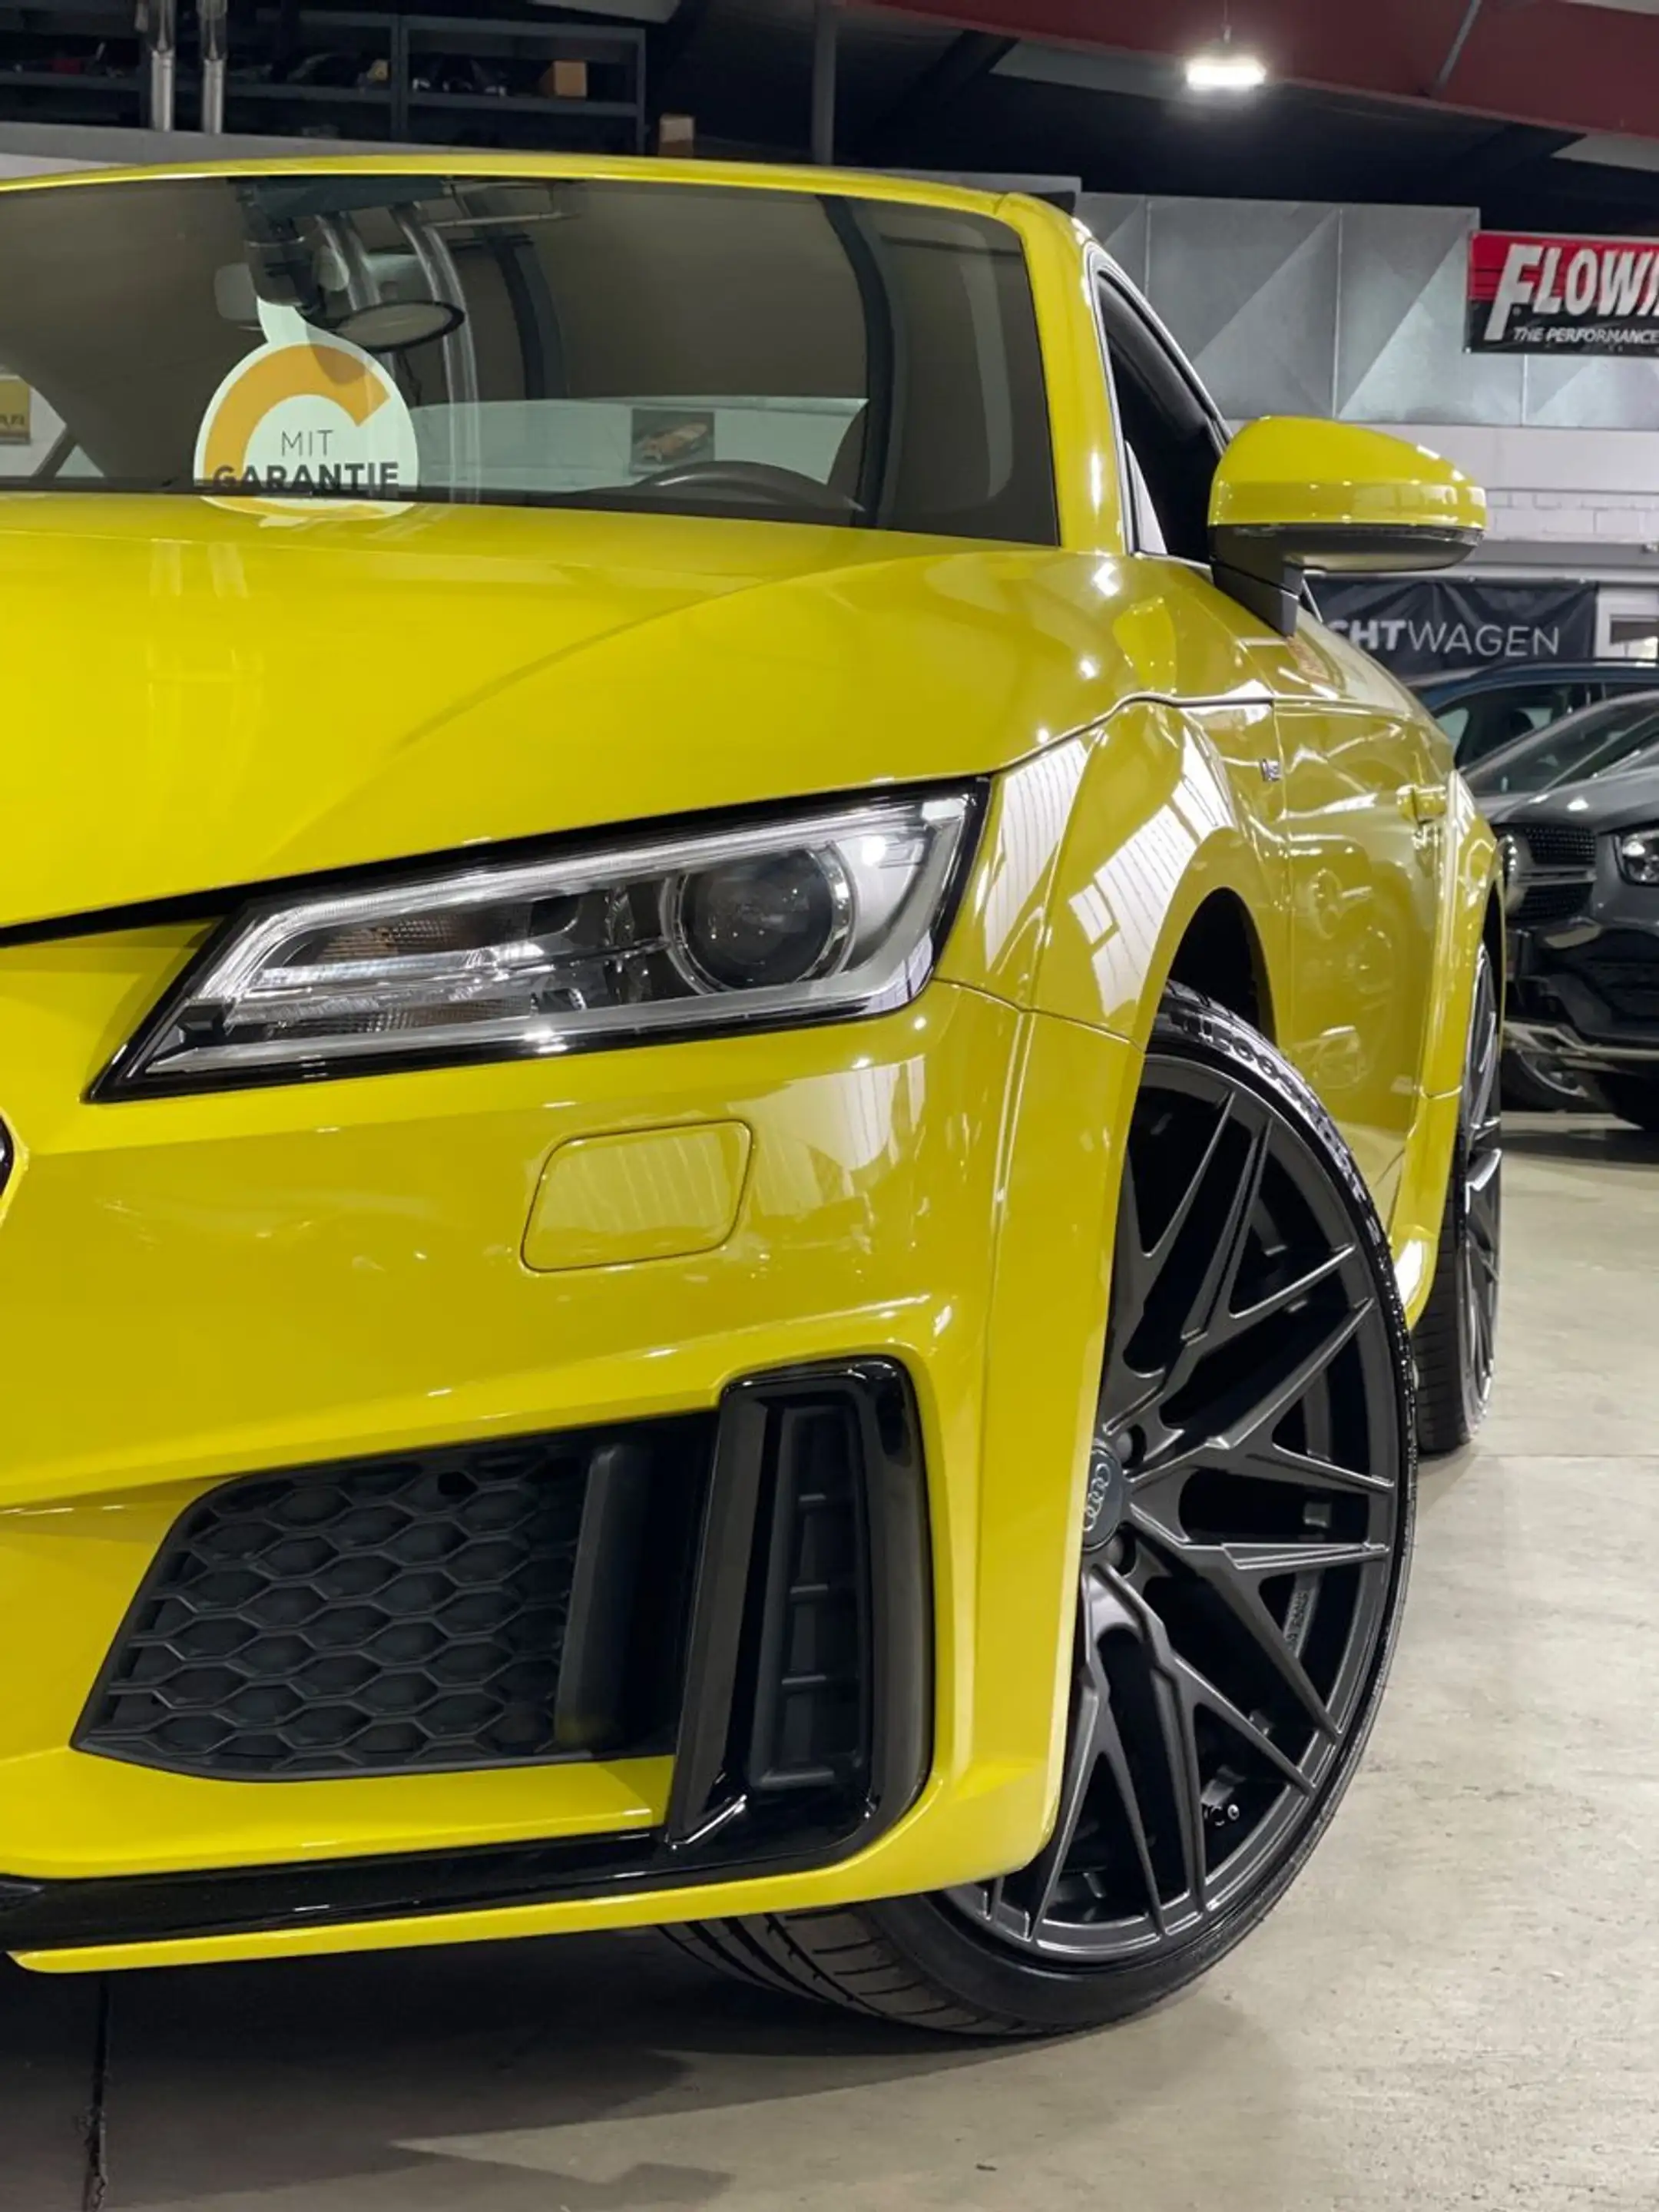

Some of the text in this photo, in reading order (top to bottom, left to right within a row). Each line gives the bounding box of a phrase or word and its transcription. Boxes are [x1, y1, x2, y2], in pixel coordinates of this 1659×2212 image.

[1513, 326, 1659, 344] THE PERFORMANCE
[281, 429, 333, 457] MIT
[212, 462, 399, 494] GARANTIE
